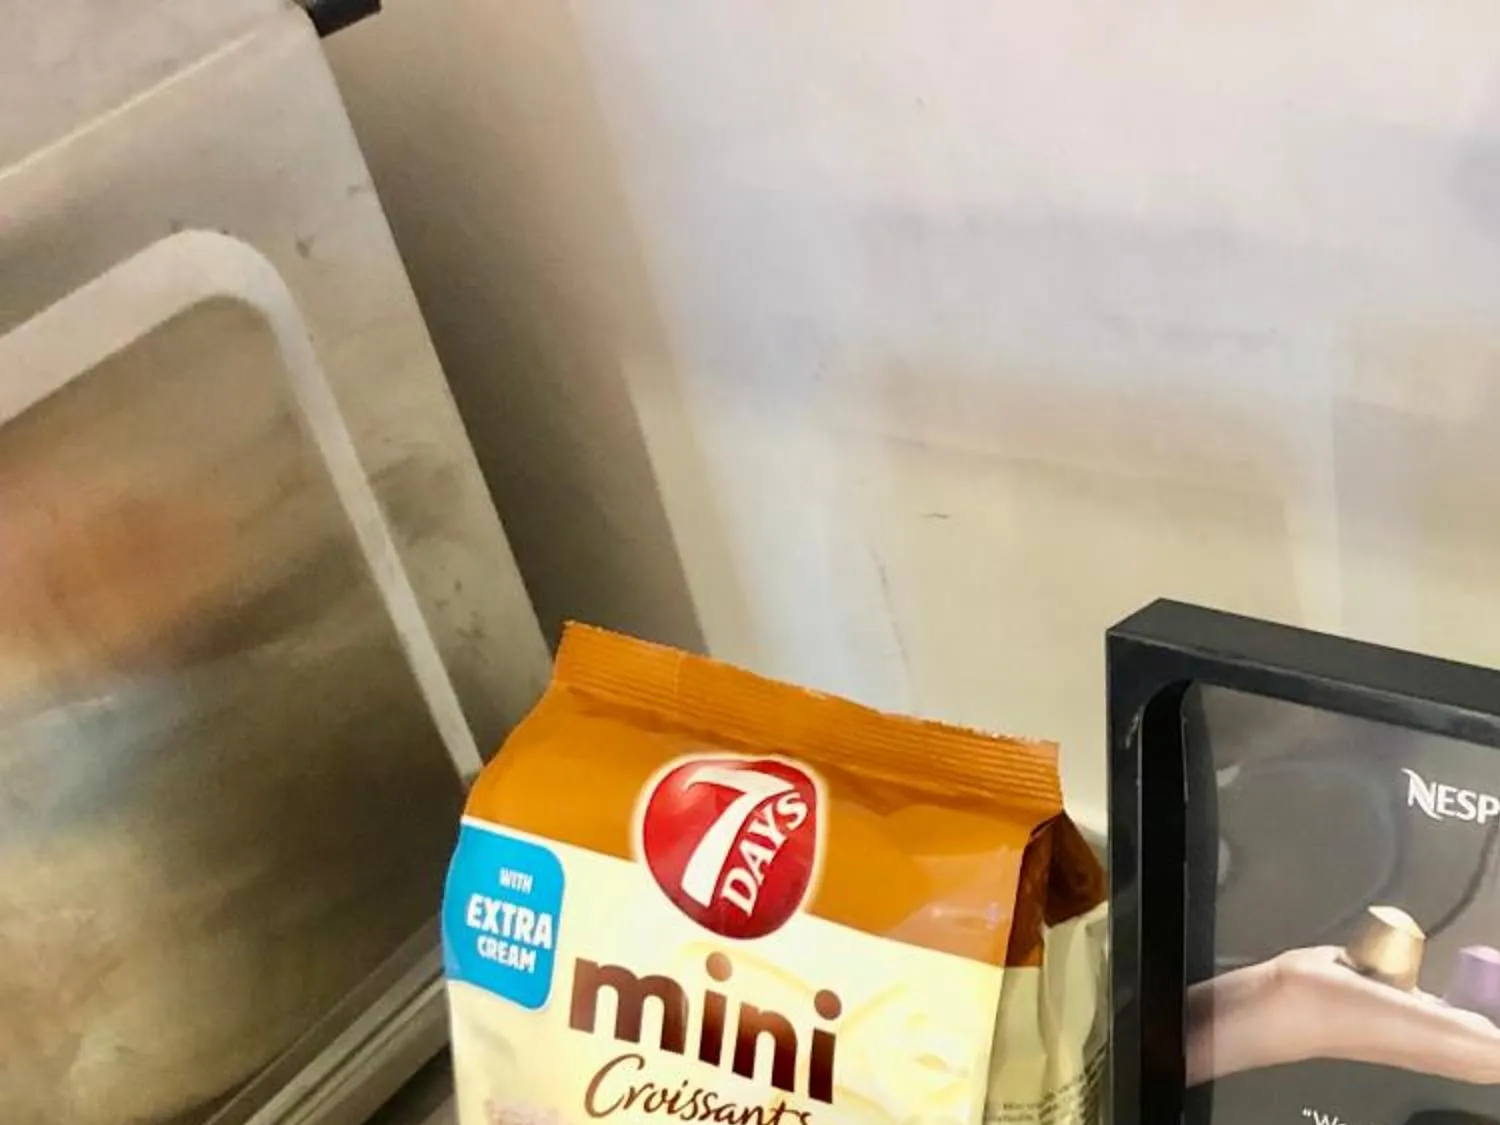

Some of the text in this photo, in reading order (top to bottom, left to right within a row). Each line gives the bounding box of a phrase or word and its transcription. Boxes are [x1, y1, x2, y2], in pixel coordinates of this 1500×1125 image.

[681, 765, 808, 917] 7 DAYS
[500, 867, 533, 894] WITH
[465, 894, 553, 949] EXTRA
[476, 935, 537, 974] CREAM
[568, 950, 842, 1105] mini
